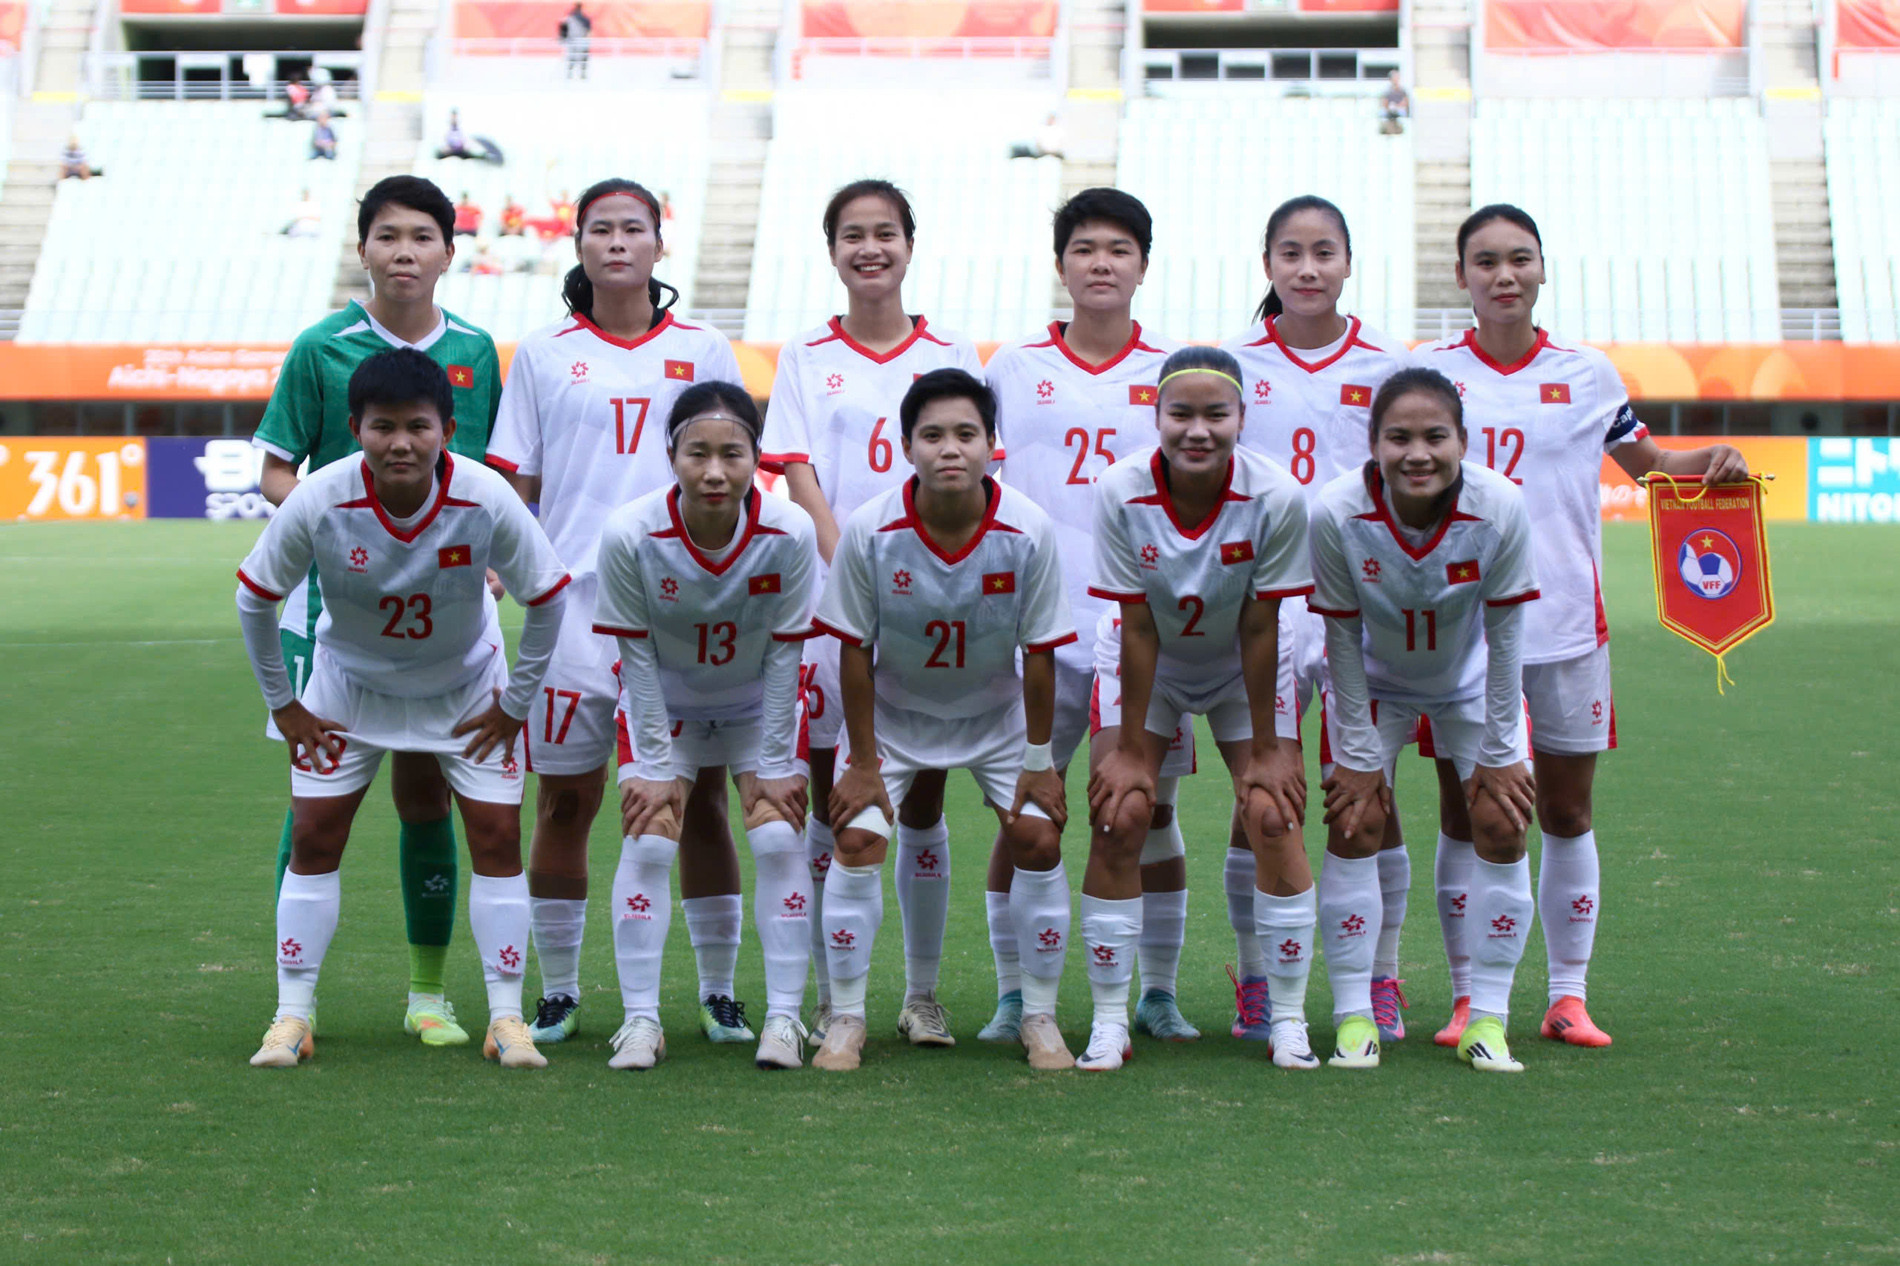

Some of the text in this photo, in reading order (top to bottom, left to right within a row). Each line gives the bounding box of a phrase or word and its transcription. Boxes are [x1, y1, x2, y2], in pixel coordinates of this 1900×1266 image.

[609, 398, 651, 454] 17
[867, 417, 893, 473] 6
[1064, 427, 1117, 485] 25
[1290, 427, 1316, 485] 8
[1482, 427, 1525, 485] 12
[1715, 497, 1750, 509] FEDERATION
[1702, 580, 1721, 590] VFF
[378, 593, 433, 640] 23
[1178, 595, 1205, 637] 2
[1401, 608, 1436, 651] 11
[693, 621, 737, 666] 13
[924, 619, 966, 668] 21
[294, 655, 305, 699] 1
[804, 663, 824, 719] 6
[543, 686, 582, 745] 17
